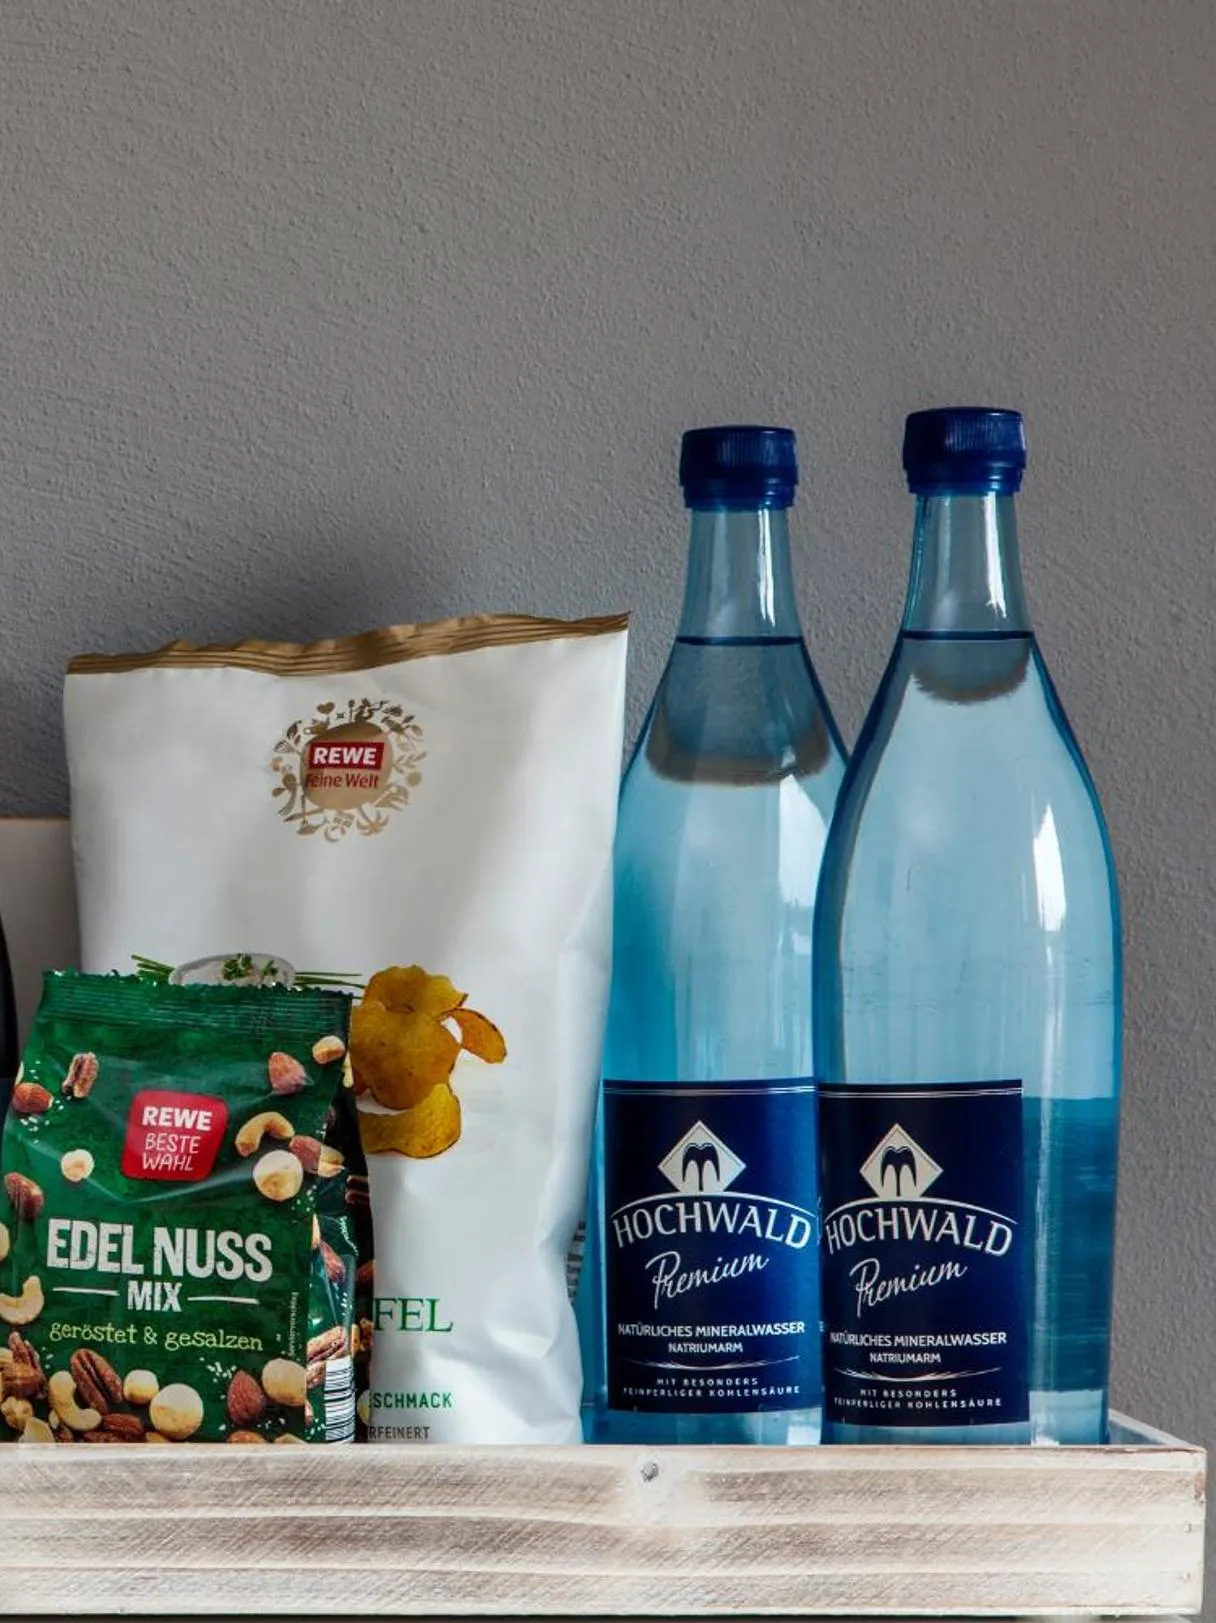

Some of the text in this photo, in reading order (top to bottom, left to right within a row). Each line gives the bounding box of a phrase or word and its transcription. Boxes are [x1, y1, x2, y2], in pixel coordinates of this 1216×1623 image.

[313, 746, 377, 766] REWE
[306, 773, 380, 789] Feine Welt
[141, 1106, 213, 1132] REWE
[144, 1132, 201, 1155] BESTE
[142, 1151, 196, 1172] WAHL
[612, 1201, 812, 1249] HOCHWALD
[825, 1207, 1013, 1257] HOCHWALD
[46, 1217, 145, 1275] EDEL
[152, 1226, 273, 1283] NUSS
[645, 1250, 770, 1310] Premium
[849, 1257, 968, 1318] Premium
[127, 1280, 182, 1313] MIX
[49, 1321, 263, 1352] geröstet & gesalzen
[617, 1321, 805, 1338] NATÜRLICHES MINERALWASSER
[830, 1330, 1007, 1347] NATÜRLICHES MINERALWASSER
[668, 1342, 744, 1353] NATRIUMARM
[870, 1352, 942, 1363] NATRIUMARM
[656, 1377, 759, 1387] MIT BESONDERS
[709, 1385, 801, 1397] KOHLENSÄURE
[860, 1388, 957, 1399] MIT BESONDERS
